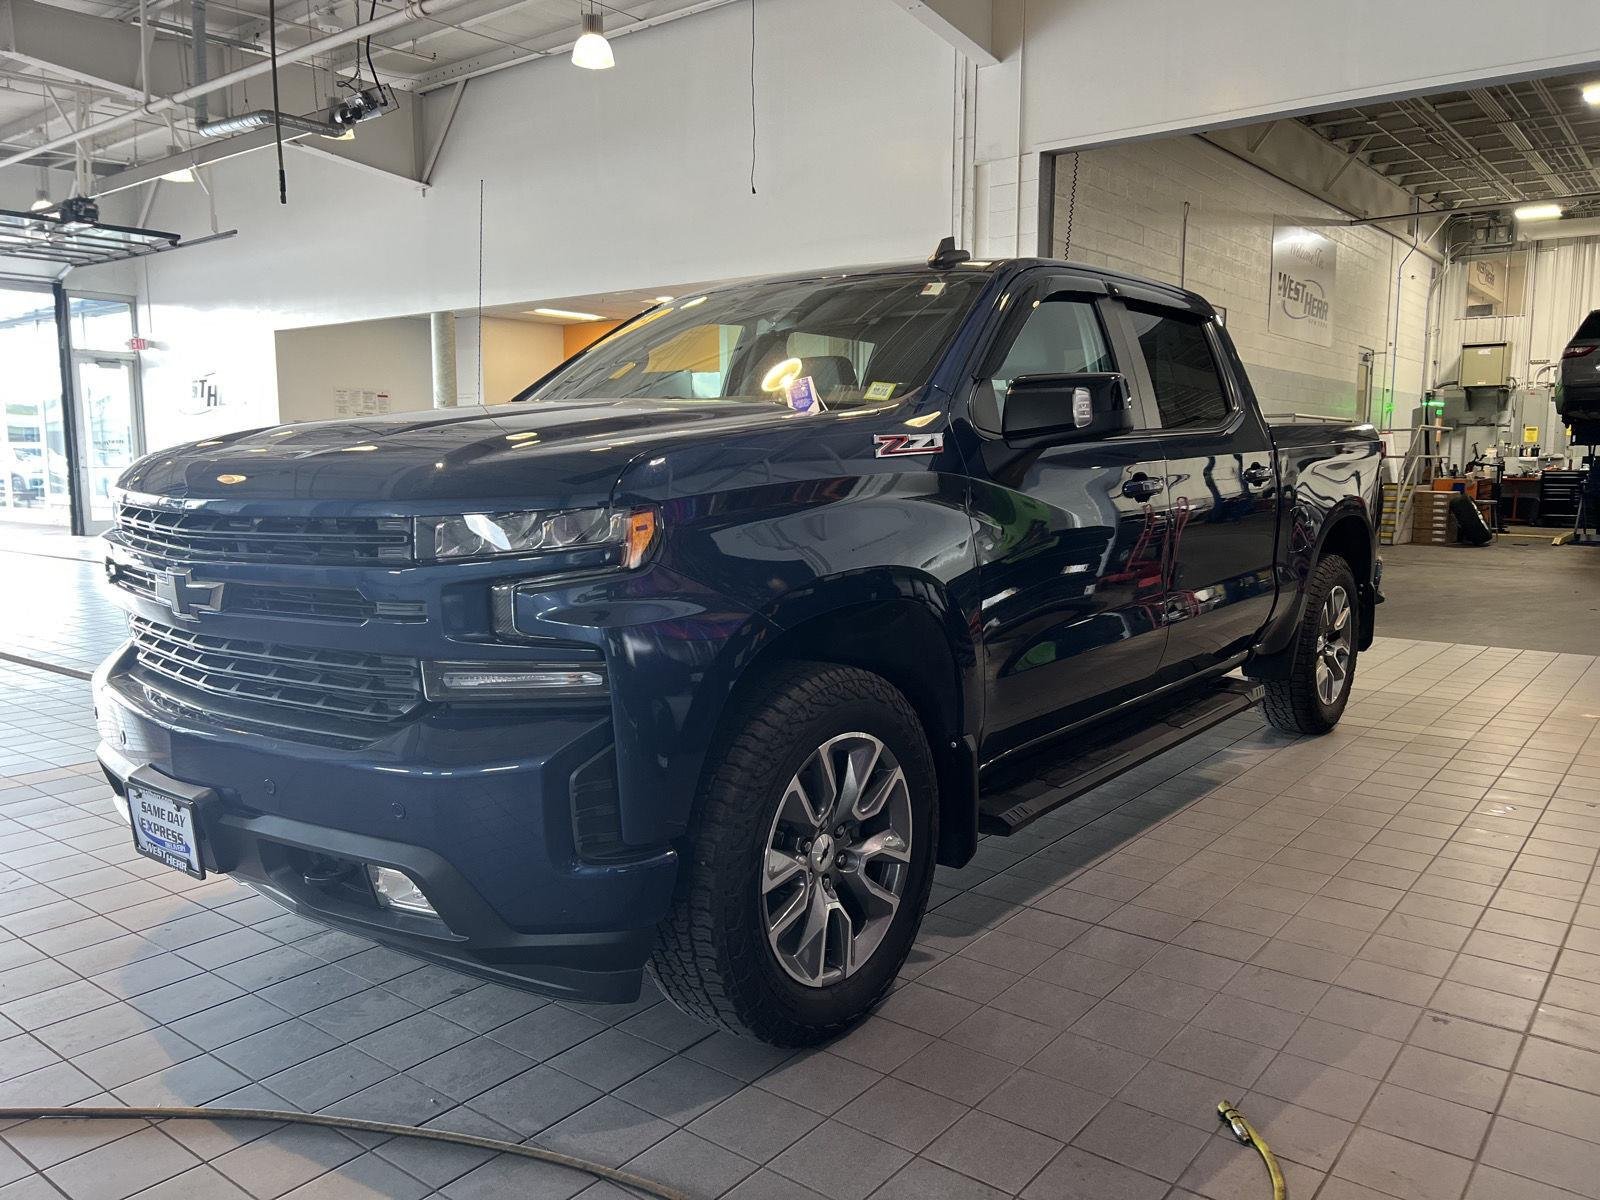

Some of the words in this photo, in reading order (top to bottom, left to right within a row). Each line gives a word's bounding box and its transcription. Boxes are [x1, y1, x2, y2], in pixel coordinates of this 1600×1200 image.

[1278, 271, 1307, 303] WEST
[1303, 292, 1329, 321] HERR
[873, 432, 944, 458] Z71
[141, 801, 166, 821] SAME
[167, 810, 186, 828] DAY
[140, 818, 184, 845] EXPRESS
[146, 841, 167, 859] WEST
[165, 853, 187, 871] HERR
